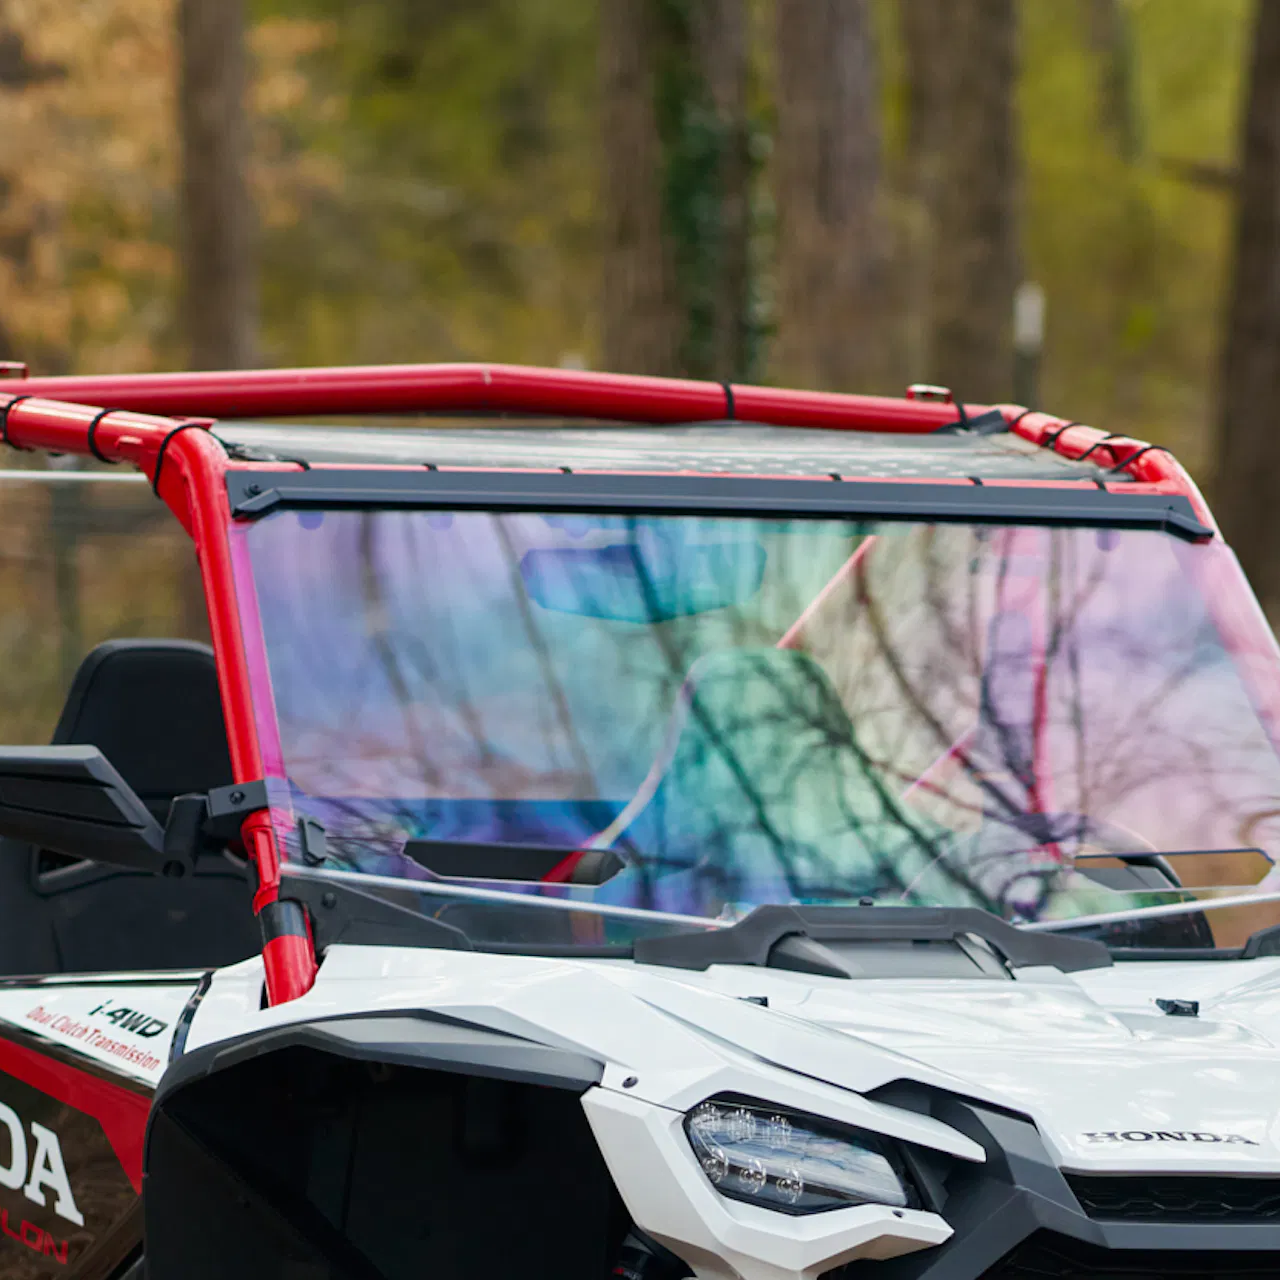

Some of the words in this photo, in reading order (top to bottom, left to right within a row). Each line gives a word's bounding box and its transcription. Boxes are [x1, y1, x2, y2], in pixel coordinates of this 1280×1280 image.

[88, 999, 168, 1038] i-4WD
[26, 1006, 55, 1024] Dual
[50, 1015, 88, 1039] Clutch
[84, 1028, 160, 1071] Transmission
[1081, 1131, 1260, 1146] HONDA
